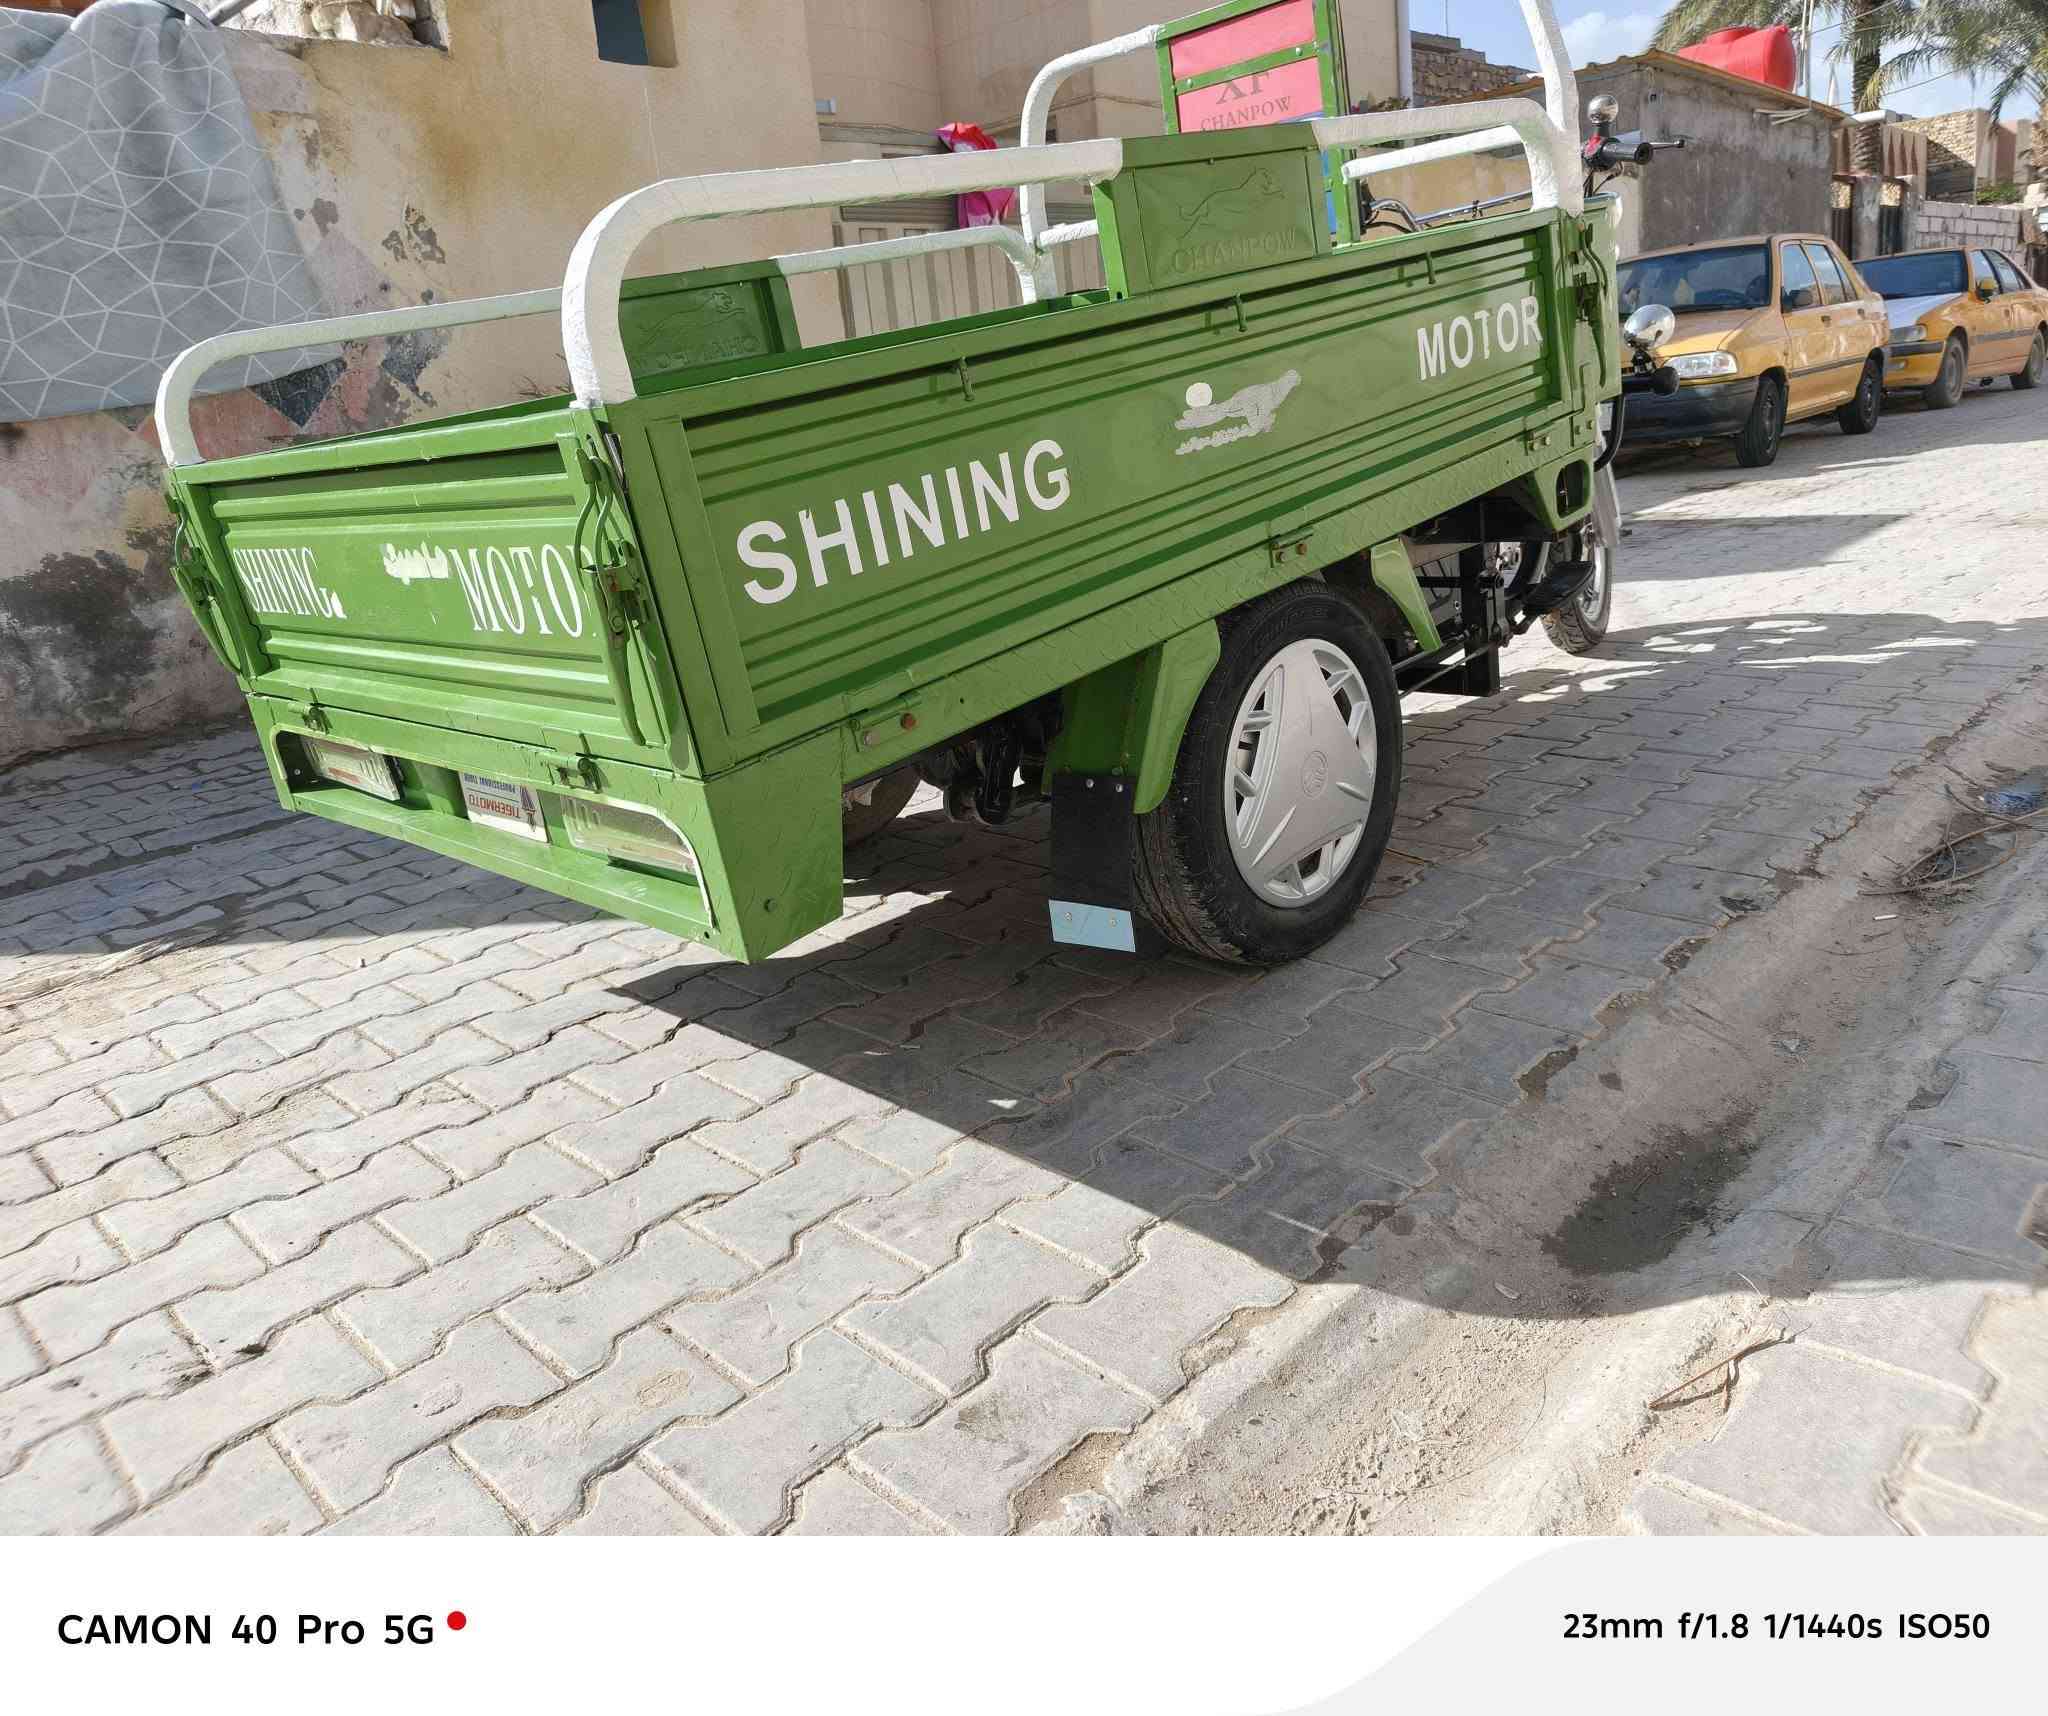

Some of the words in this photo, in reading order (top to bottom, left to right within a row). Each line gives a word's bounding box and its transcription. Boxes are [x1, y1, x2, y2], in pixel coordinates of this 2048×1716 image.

[1201, 95, 1291, 132] CHANPOW
[1172, 226, 1295, 273] CHANPOW
[1416, 295, 1544, 382] MOTOR
[736, 439, 1071, 605] SHINING
[232, 547, 333, 618] SHINING
[468, 794, 519, 818] TIGERMOTO
